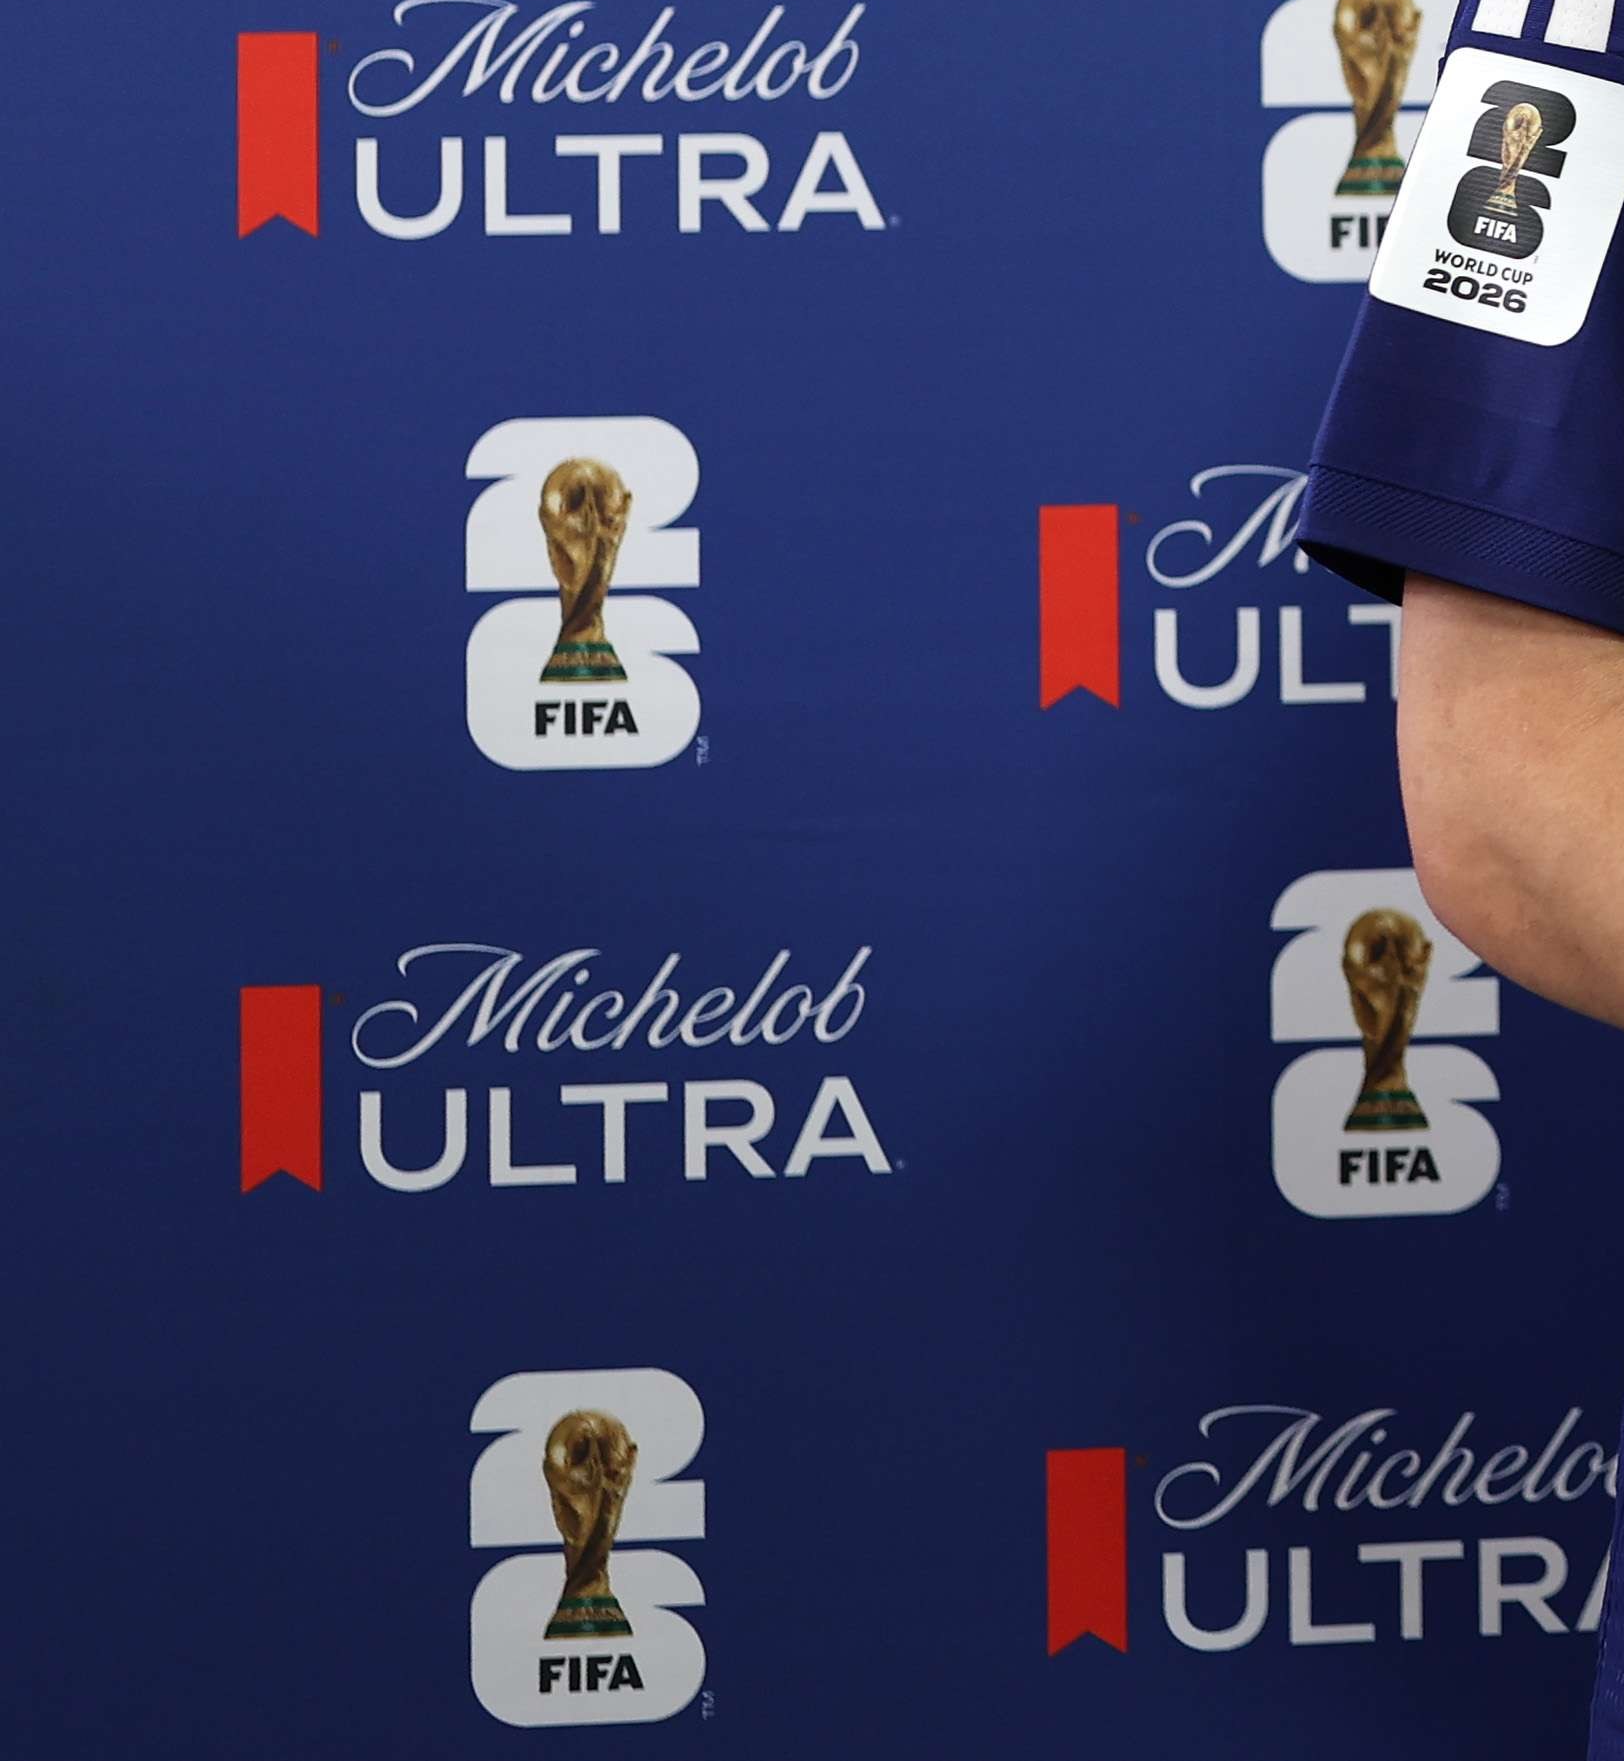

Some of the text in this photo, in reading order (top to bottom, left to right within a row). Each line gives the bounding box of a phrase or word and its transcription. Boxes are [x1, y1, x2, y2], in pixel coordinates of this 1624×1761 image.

[355, 130, 886, 241] ULTRA
[1329, 214, 1389, 250] FI
[1473, 215, 1518, 244] FIFA
[1433, 248, 1534, 286] WORLD CUP
[1422, 267, 1528, 315] 2026
[533, 699, 640, 738] FIFA
[350, 942, 873, 1069] Michelob
[358, 1075, 893, 1193] ULTRA
[1338, 1146, 1442, 1187] FIFA
[1154, 1404, 1619, 1530] Michelo
[537, 1652, 645, 1695] FIFA
